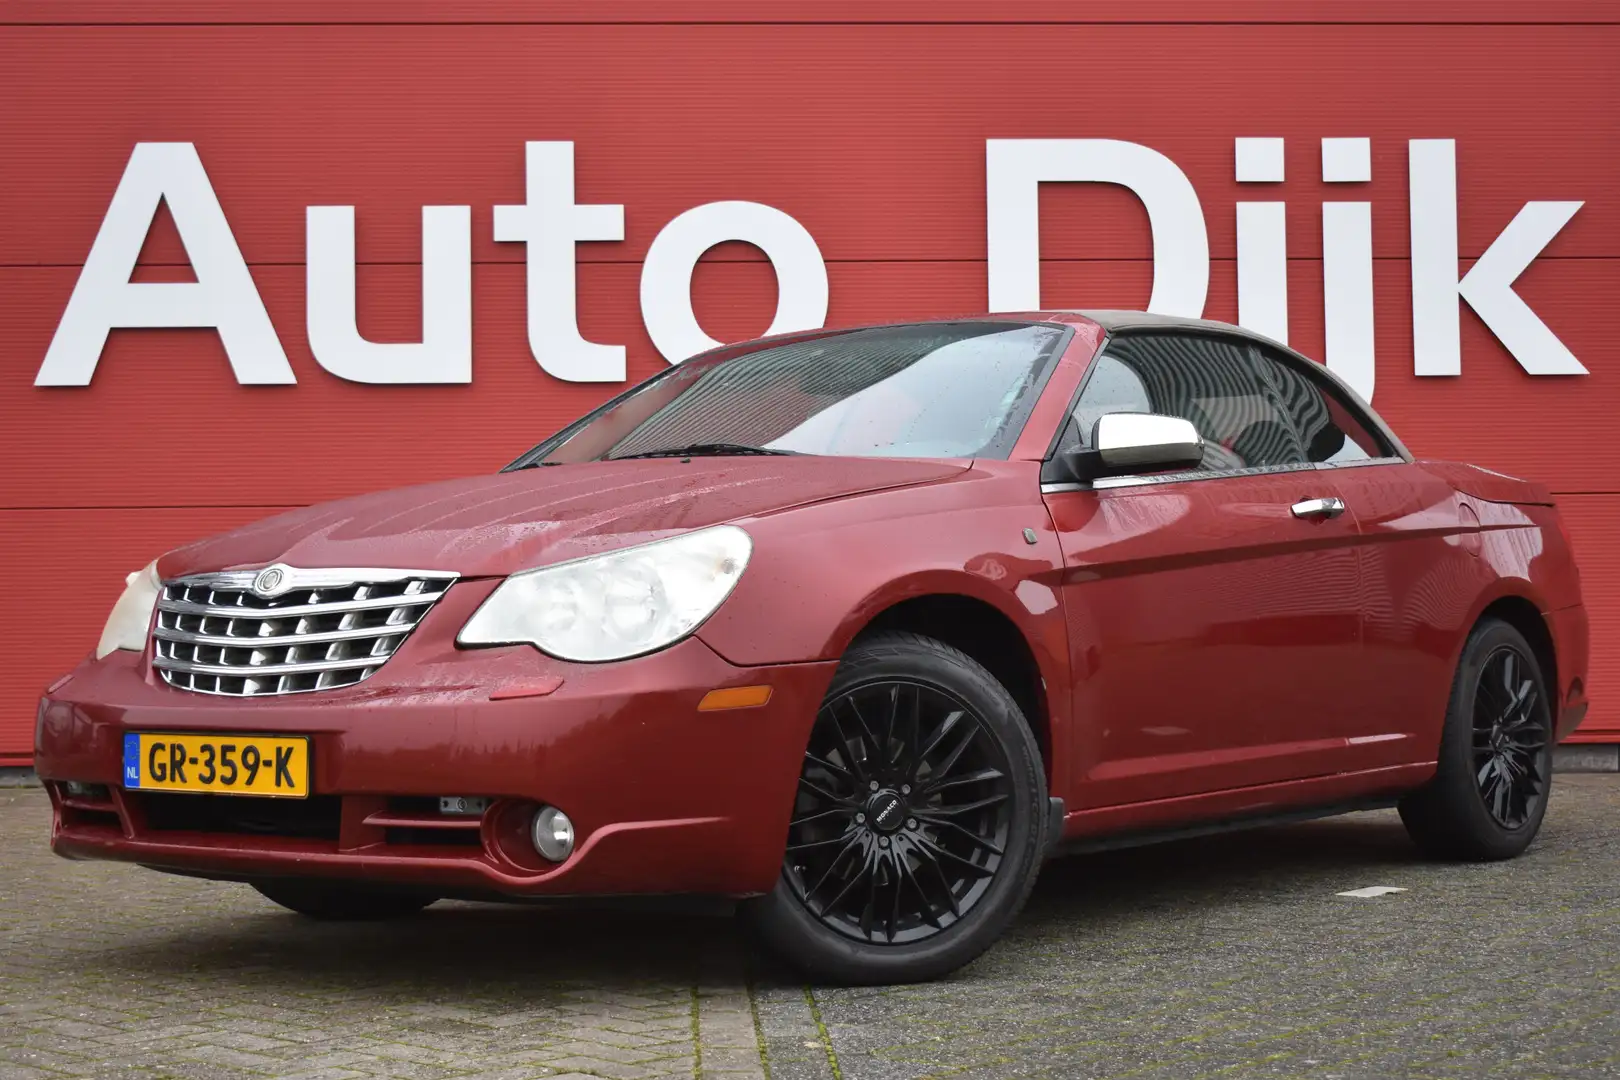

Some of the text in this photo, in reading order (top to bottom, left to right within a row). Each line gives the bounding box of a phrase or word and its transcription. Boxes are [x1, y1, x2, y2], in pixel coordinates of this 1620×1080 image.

[34, 137, 1590, 405] Auto Dijk
[127, 766, 139, 779] NL
[149, 743, 295, 787] GR-359-K
[876, 799, 897, 822] MONACO
